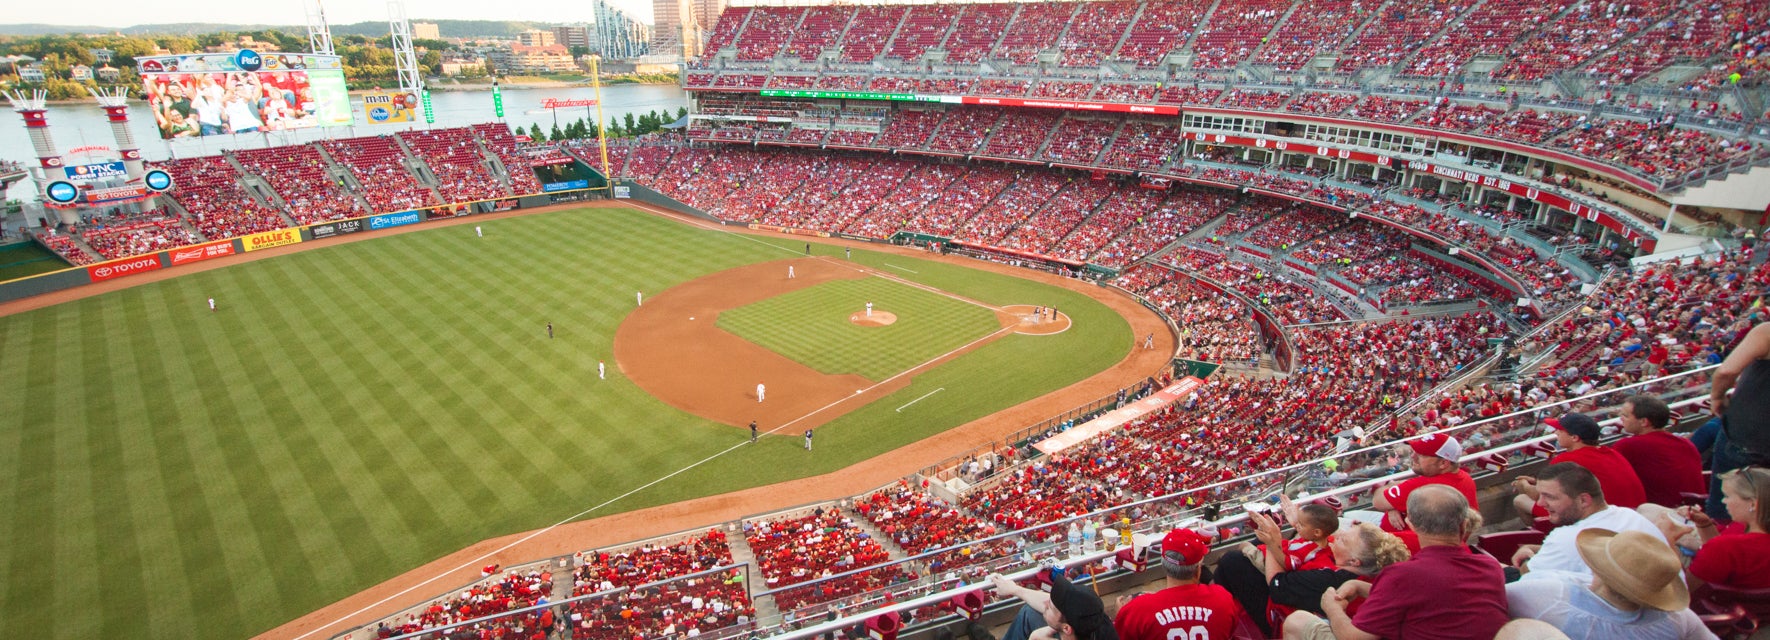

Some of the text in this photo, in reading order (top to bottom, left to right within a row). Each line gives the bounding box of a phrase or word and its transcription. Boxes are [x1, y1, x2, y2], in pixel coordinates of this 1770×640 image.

[241, 56, 259, 65] P&G
[88, 163, 116, 175] PNC
[1433, 165, 1463, 179] CINCINNATI
[1464, 172, 1480, 183] REDS
[109, 190, 139, 198] TOYOTA
[338, 221, 360, 229] JACK
[252, 231, 292, 245] OLLIE'S
[114, 258, 156, 273] TOYOTA
[1155, 606, 1212, 625] GRIFFEY
